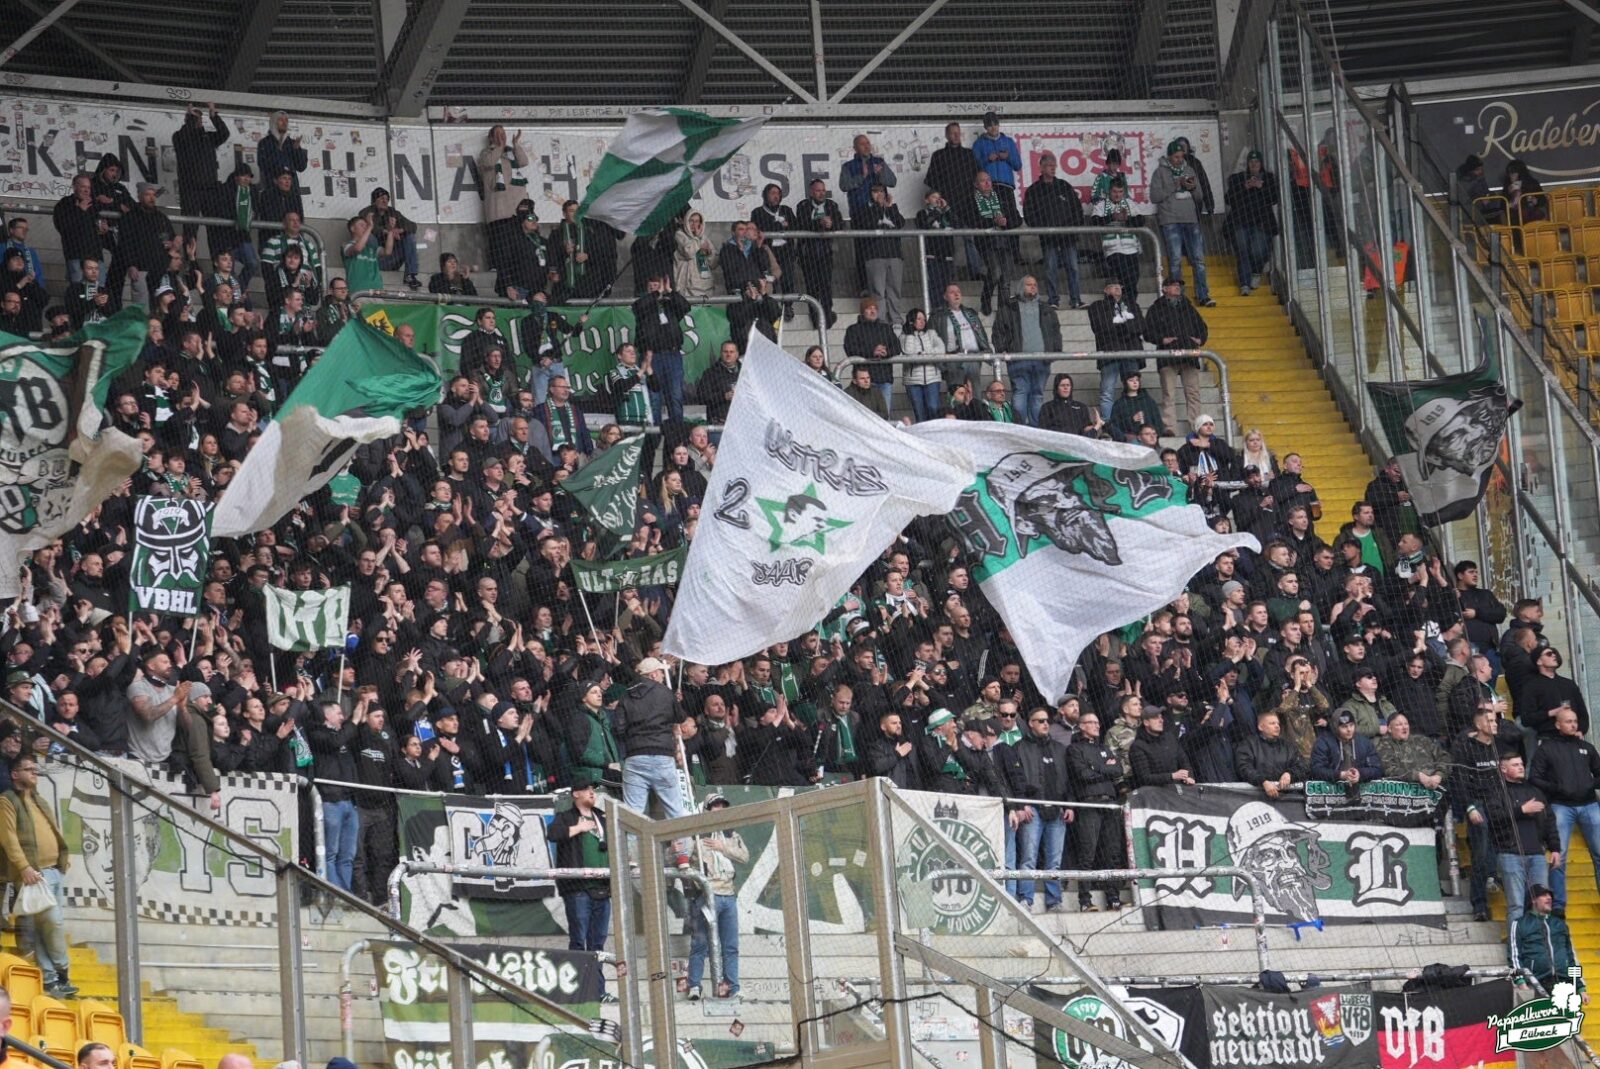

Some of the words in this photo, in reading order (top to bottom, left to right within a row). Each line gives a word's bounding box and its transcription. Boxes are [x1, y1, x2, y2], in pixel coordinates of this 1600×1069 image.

[764, 418, 889, 497] ULTRAS
[713, 477, 752, 530] 2
[136, 585, 197, 614] VBHL
[1247, 812, 1273, 831] 1919
[1346, 831, 1413, 907] L
[1340, 1006, 1371, 1032] VfB
[1380, 1005, 1446, 1069] VfB
[1209, 1031, 1326, 1067] neustadt
